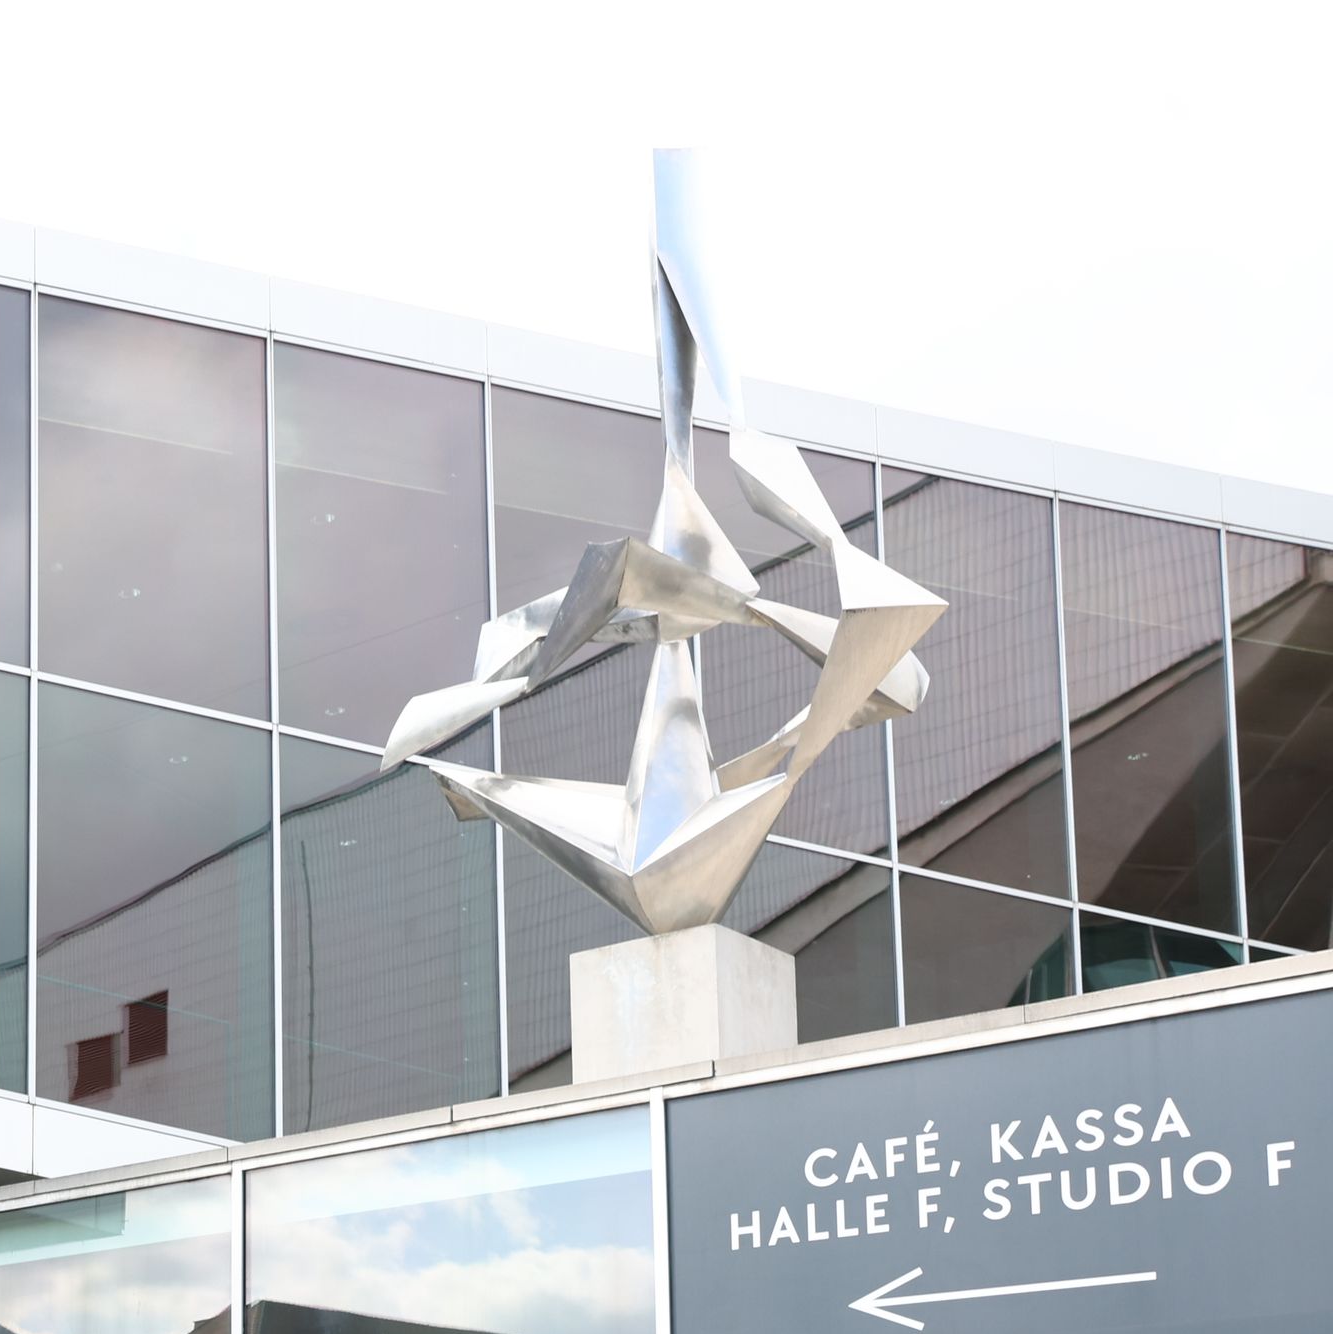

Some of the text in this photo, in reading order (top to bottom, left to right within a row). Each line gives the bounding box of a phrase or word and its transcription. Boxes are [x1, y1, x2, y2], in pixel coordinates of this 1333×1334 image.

[803, 1097, 1191, 1189] CAFÉ, KASSA
[729, 1140, 1296, 1251] HALLE F, STUDIO F
